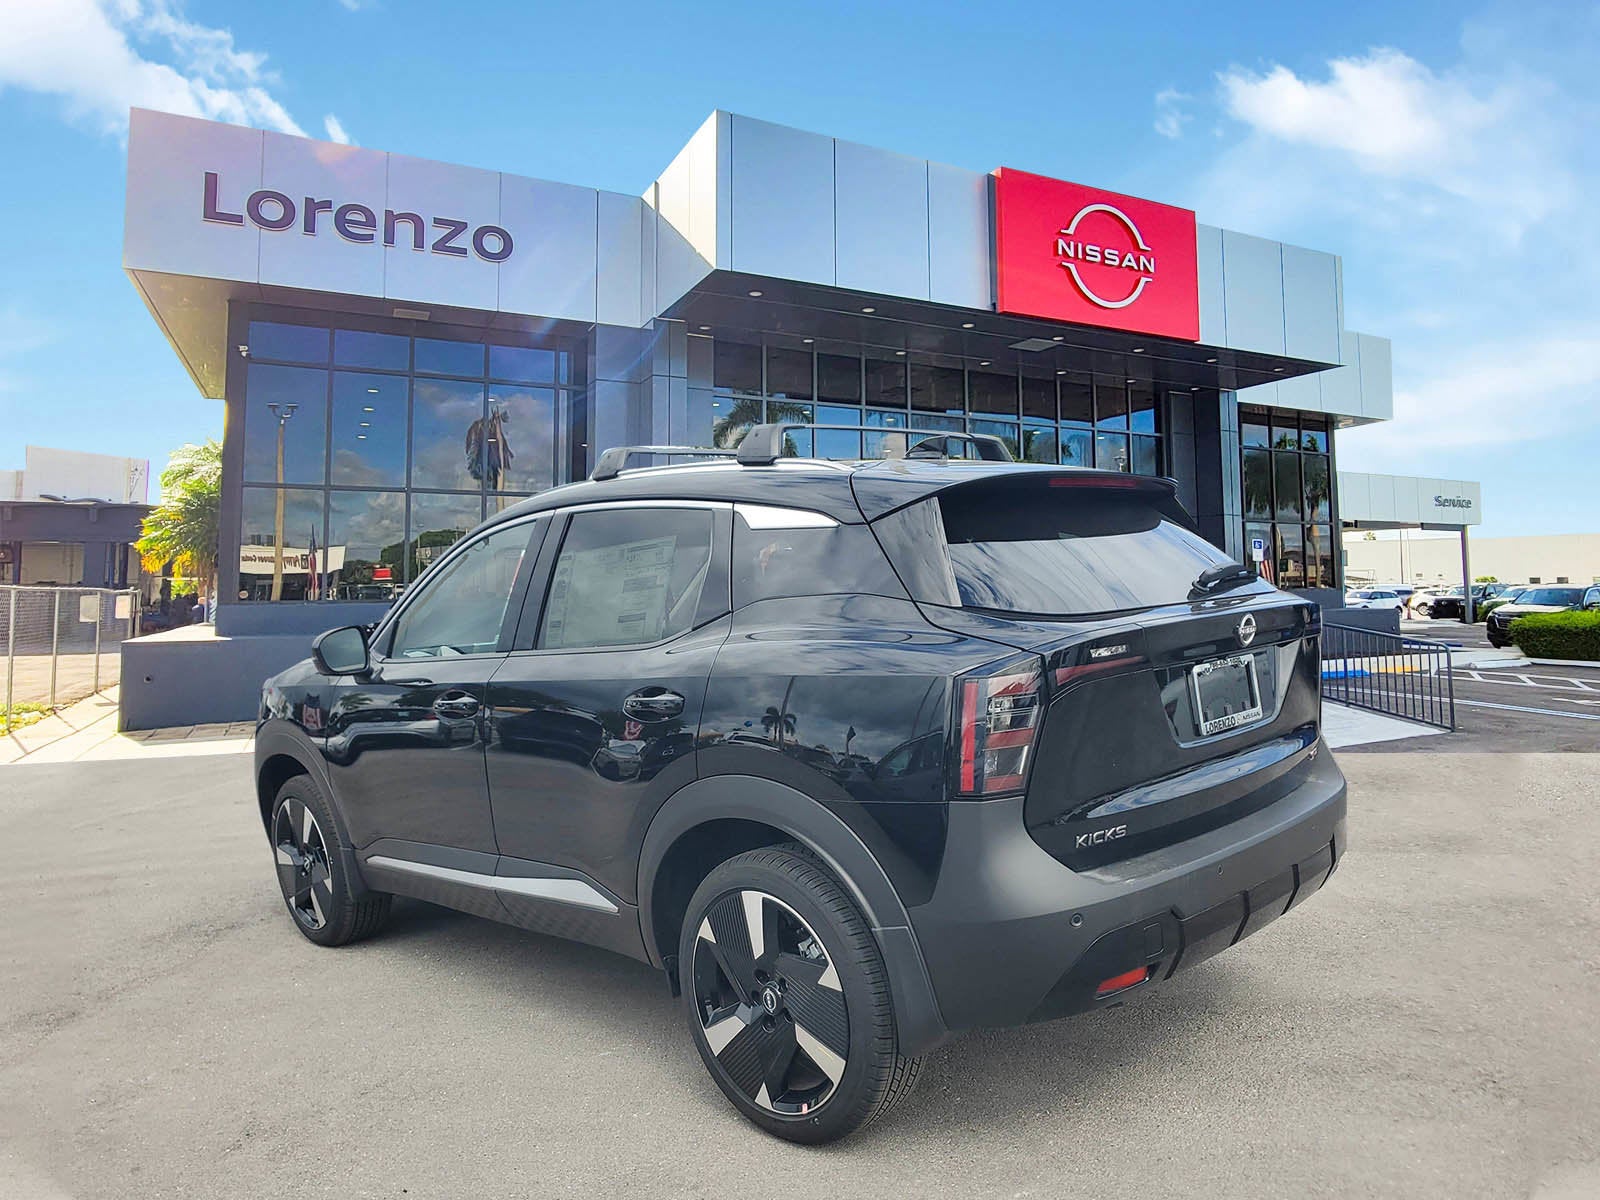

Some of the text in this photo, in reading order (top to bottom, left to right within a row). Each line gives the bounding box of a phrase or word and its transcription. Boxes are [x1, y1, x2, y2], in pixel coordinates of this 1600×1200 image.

[202, 171, 514, 263] Lorenzo
[1057, 238, 1155, 273] NISSAN
[1433, 495, 1472, 509] Service
[1205, 717, 1236, 735] LORENZO
[1075, 824, 1127, 849] KICKS
